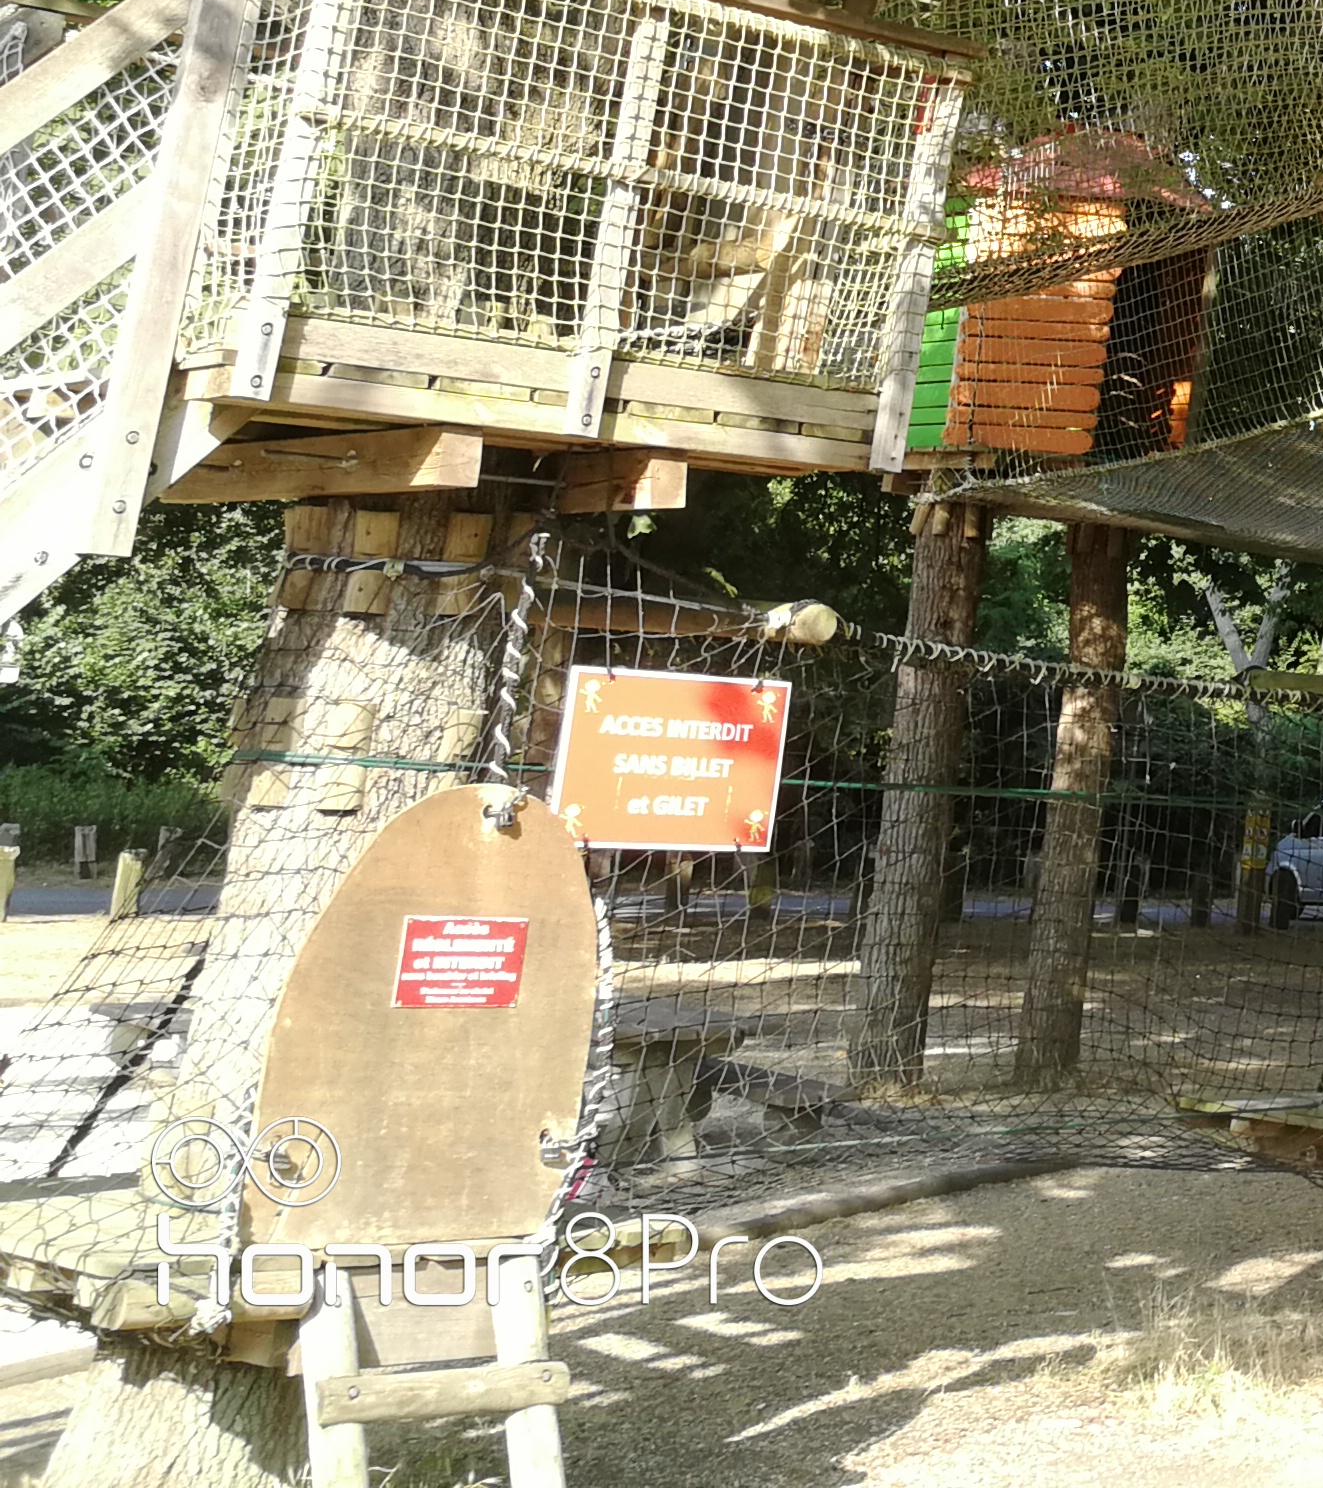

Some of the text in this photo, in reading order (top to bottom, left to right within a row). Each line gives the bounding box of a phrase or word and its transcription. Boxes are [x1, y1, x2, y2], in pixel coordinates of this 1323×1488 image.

[599, 714, 753, 742] ACCES INTERDIT
[613, 753, 734, 778] SANS BILLET
[627, 795, 709, 816] et GILET
